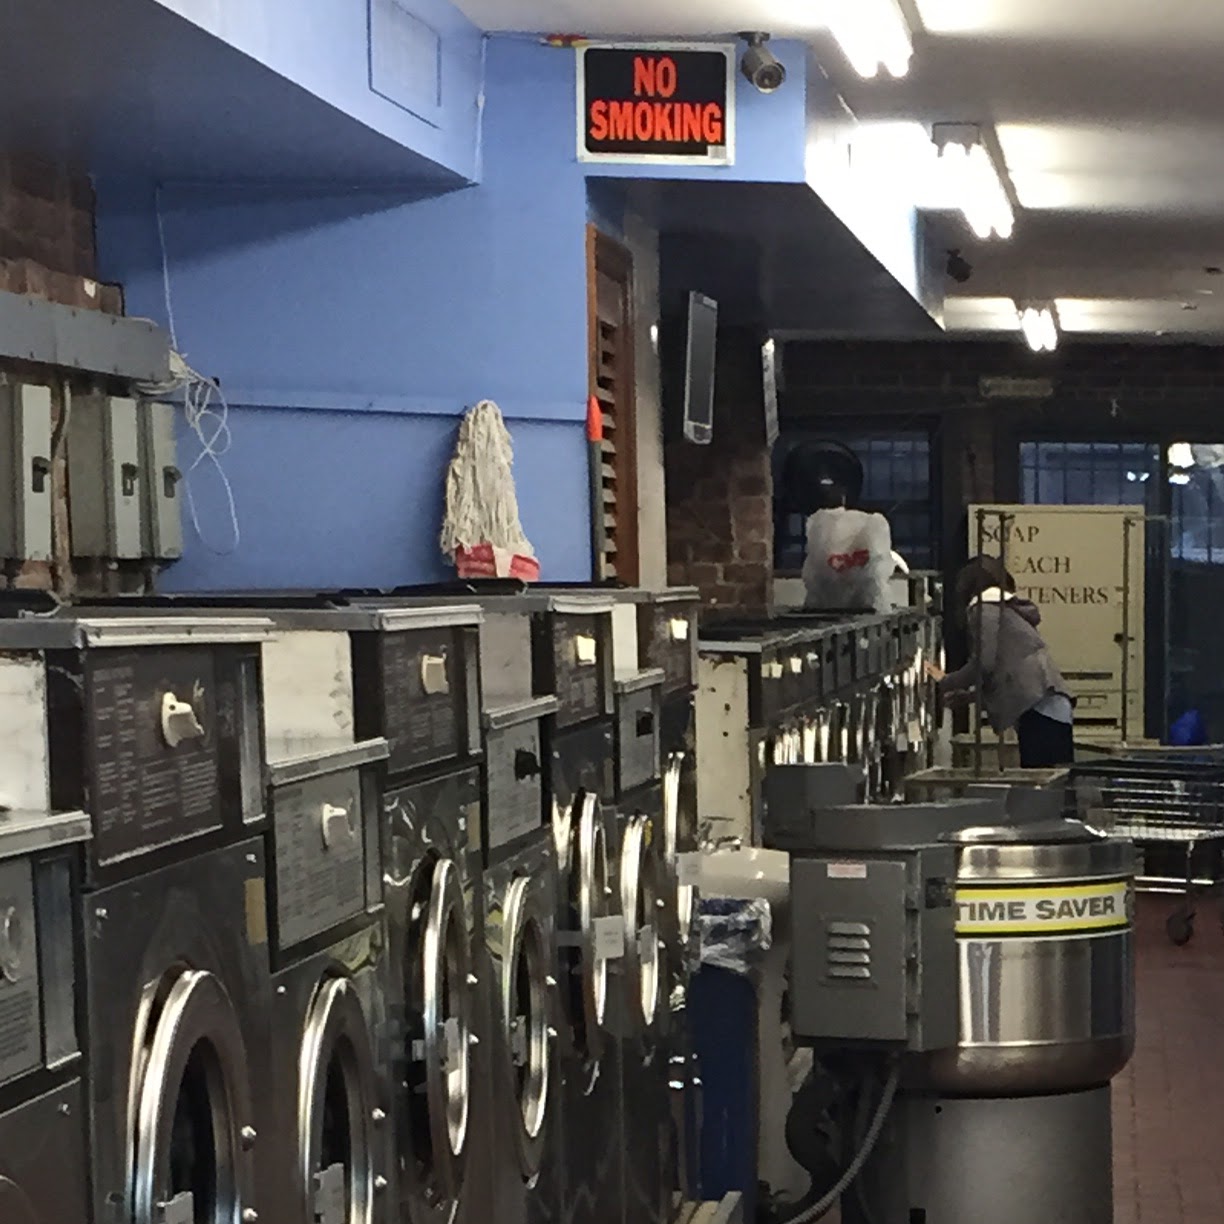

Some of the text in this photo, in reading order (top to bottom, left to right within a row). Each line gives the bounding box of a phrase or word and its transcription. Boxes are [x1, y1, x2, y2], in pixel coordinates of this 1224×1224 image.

[633, 55, 677, 97] NO
[589, 100, 722, 143] SMOKING
[1013, 556, 1071, 574] EACH
[1035, 895, 1115, 921] SAVER
